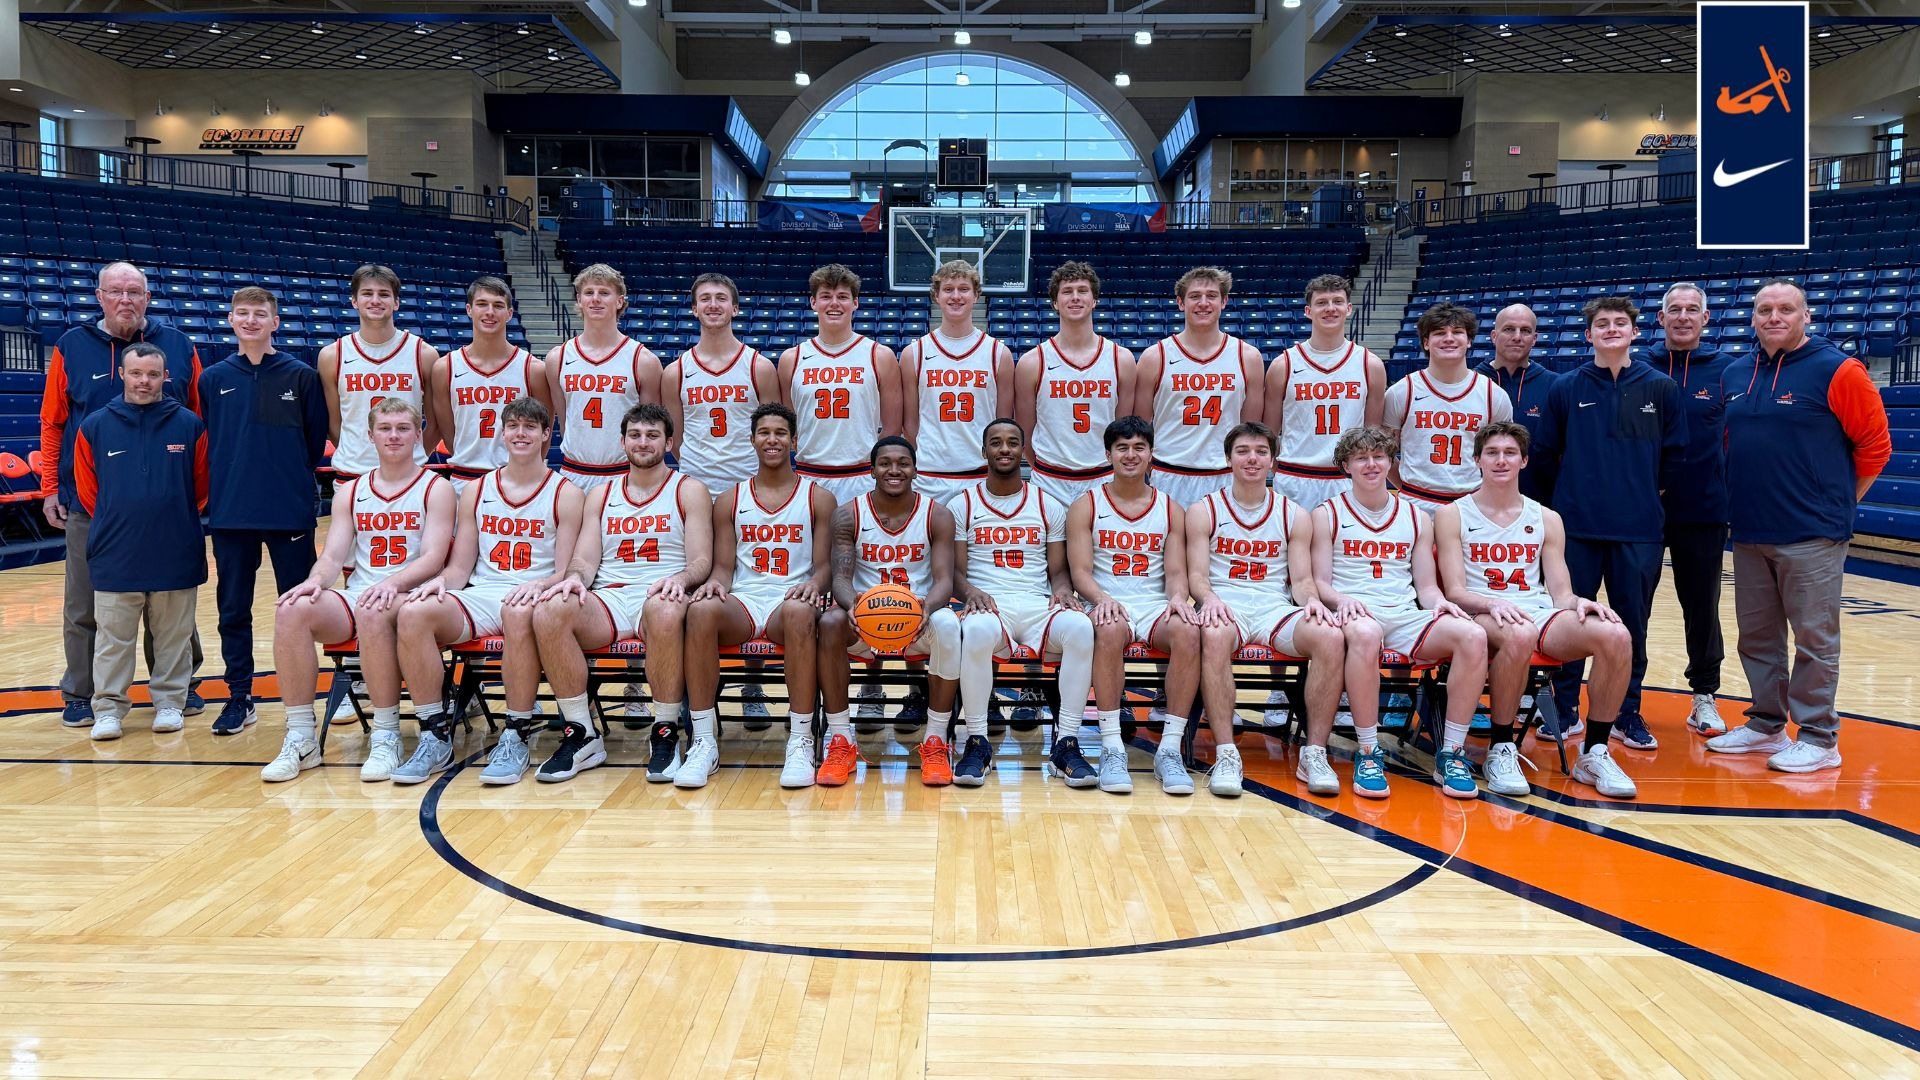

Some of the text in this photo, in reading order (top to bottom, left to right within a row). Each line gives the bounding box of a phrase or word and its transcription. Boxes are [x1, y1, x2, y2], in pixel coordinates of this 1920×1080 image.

[229, 125, 304, 143] ORANGE!
[1640, 134, 1666, 148] GO
[346, 373, 413, 392] HOPE
[564, 374, 628, 394] HOPE
[803, 367, 864, 385] HOPE
[926, 369, 989, 388] HOPE
[1173, 373, 1235, 392] HOPE
[456, 386, 521, 405] HOPE
[687, 385, 748, 405] HOPE
[1049, 380, 1111, 399] HOPE
[1295, 381, 1361, 401] HOPE
[582, 398, 603, 429] 4
[815, 388, 849, 419] 32
[939, 392, 975, 422] 23
[1183, 396, 1222, 425] 24
[479, 409, 497, 439] 2
[710, 408, 728, 437] 3
[1072, 403, 1091, 434] 5
[1315, 405, 1340, 435] 11
[1415, 411, 1482, 433] HOPE
[1430, 434, 1461, 465] 31
[356, 512, 420, 532] HOPE
[480, 514, 545, 538] HOPE
[607, 515, 671, 535] HOPE
[741, 524, 803, 543] HOPE
[975, 527, 1041, 545] HOPE
[1098, 530, 1162, 552] HOPE
[369, 535, 407, 568] 25
[490, 541, 532, 571] 40
[615, 538, 659, 562] 44
[862, 543, 924, 563] HOPE
[1215, 536, 1281, 558] HOPE
[1343, 539, 1410, 560] HOPE
[1470, 543, 1539, 564] HOPE
[752, 547, 789, 576] 33
[994, 550, 1024, 569] 10
[1112, 553, 1149, 576] 22
[879, 568, 910, 591] 12
[1228, 560, 1269, 580] 20
[1371, 561, 1383, 579] 1
[1485, 568, 1531, 591] 34
[867, 596, 913, 610] Wilson
[877, 623, 905, 632] EVO
[485, 640, 504, 651] HO
[609, 641, 646, 653] HOPE
[739, 642, 776, 654] HOPE
[1383, 653, 1401, 662] PE
